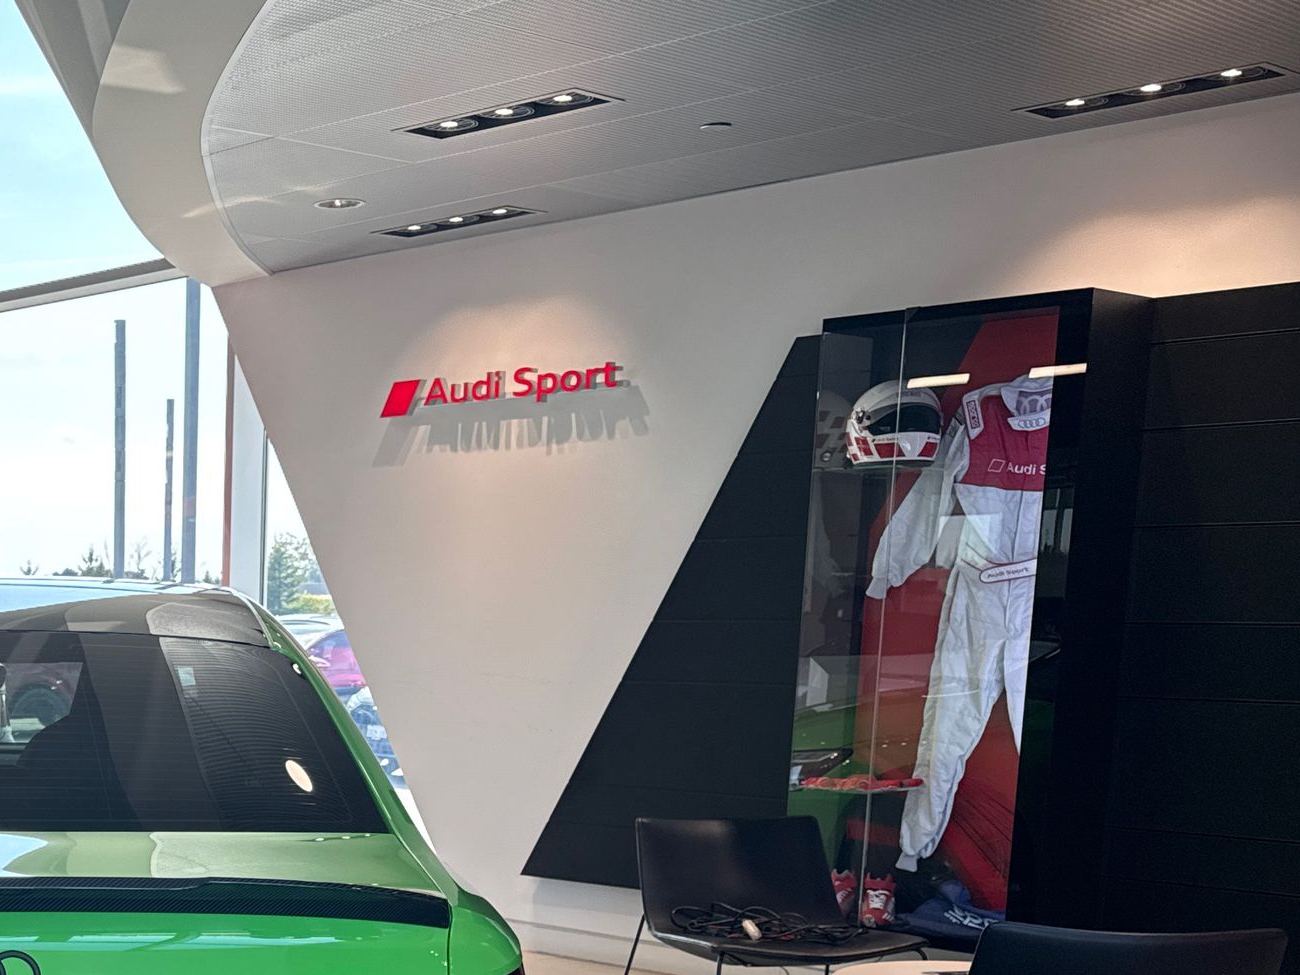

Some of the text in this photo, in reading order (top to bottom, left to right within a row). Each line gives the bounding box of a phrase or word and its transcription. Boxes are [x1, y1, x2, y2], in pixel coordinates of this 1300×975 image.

[423, 361, 622, 407] Audi Sport
[1007, 461, 1037, 475] Audi
